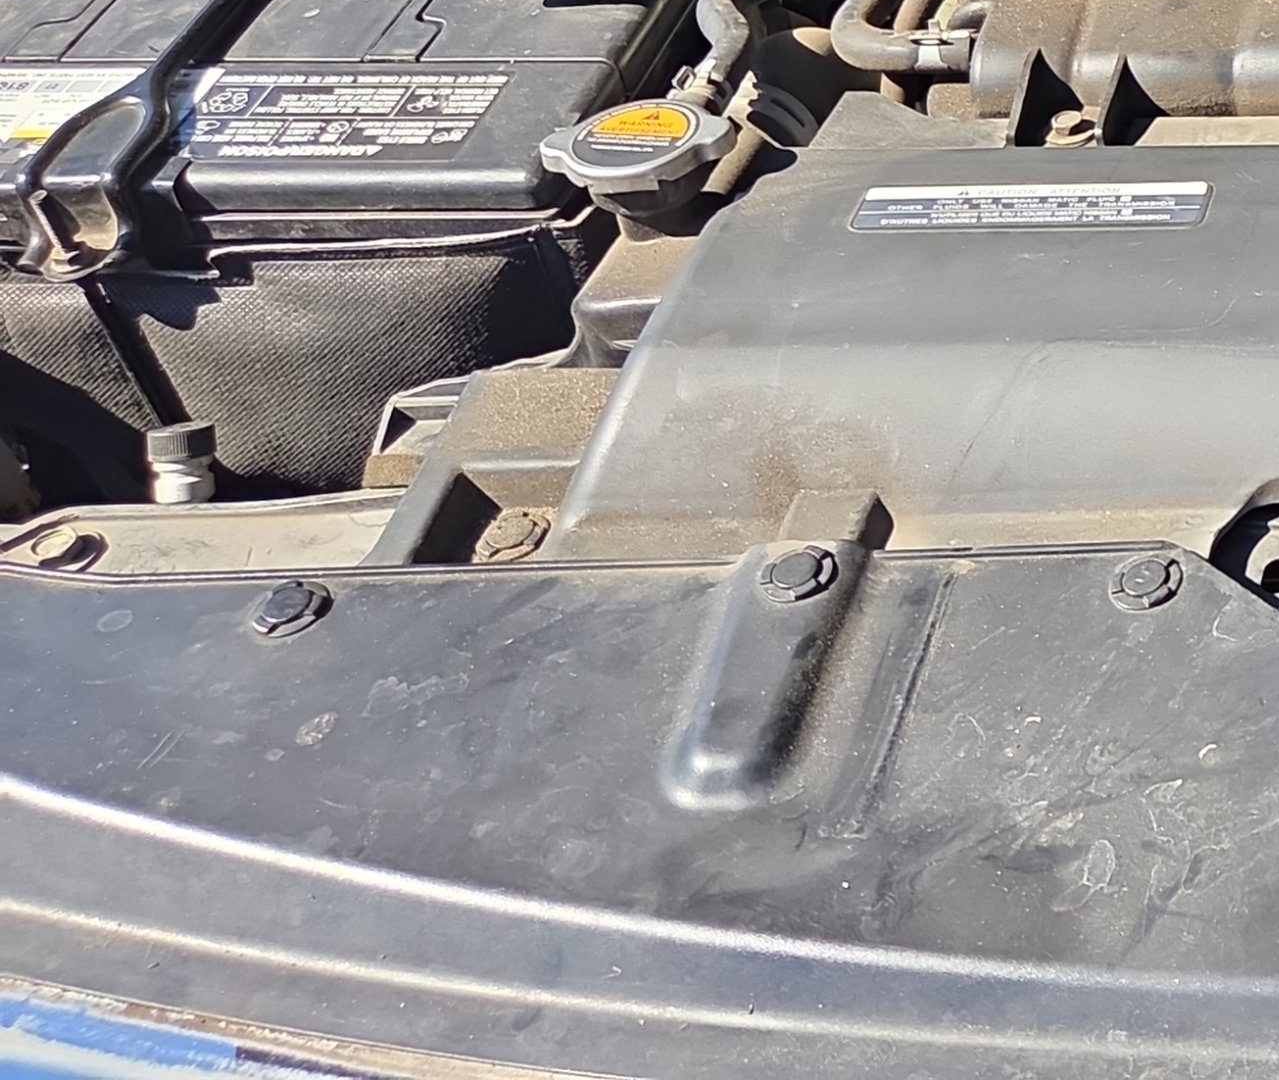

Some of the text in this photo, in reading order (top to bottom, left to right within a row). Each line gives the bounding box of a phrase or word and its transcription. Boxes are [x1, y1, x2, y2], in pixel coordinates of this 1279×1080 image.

[618, 120, 674, 128] WARNING
[977, 187, 1121, 196] CAUTION ATTENTION
[1098, 200, 1177, 208] TRANSMISSION
